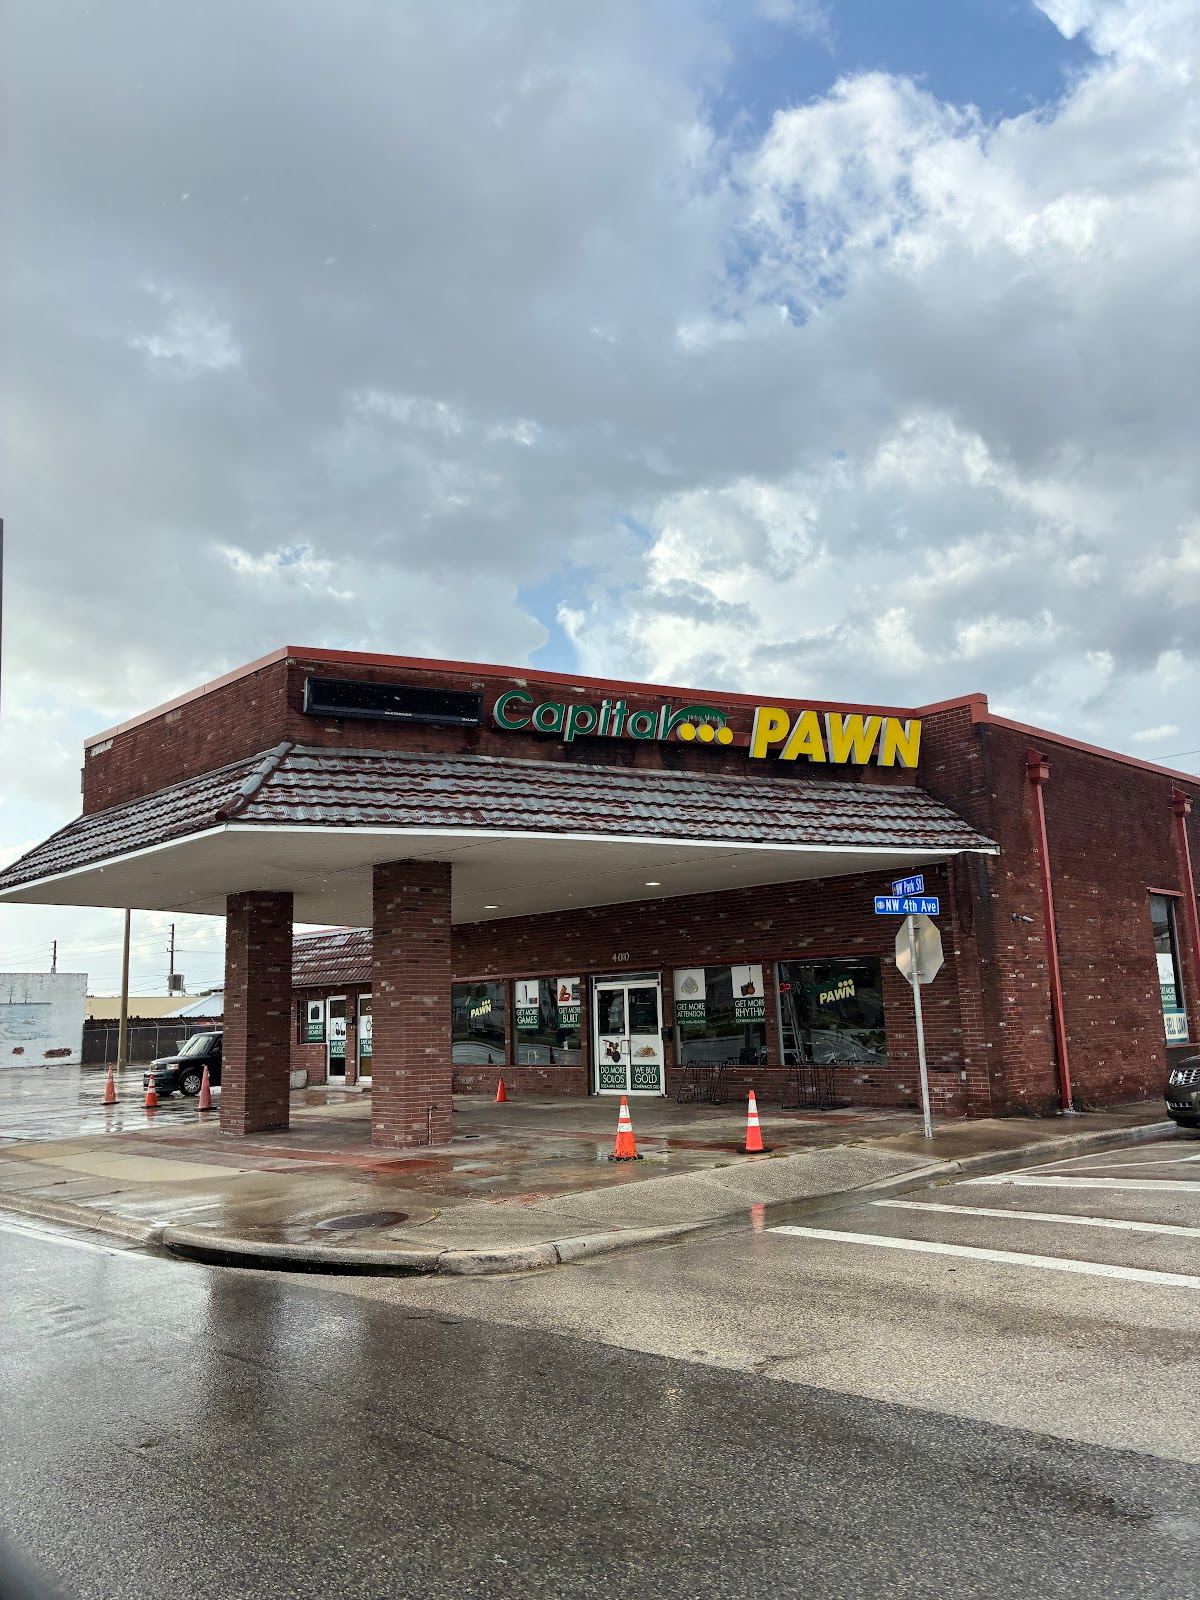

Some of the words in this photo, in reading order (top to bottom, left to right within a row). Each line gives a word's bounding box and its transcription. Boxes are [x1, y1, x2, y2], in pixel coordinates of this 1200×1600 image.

[493, 690, 686, 742] Capital
[749, 706, 922, 768] PAWN
[903, 880, 915, 893] Park
[915, 878, 922, 891] St
[885, 899, 899, 911] NW
[903, 899, 918, 912] 4th
[921, 900, 936, 912] Ave
[611, 951, 630, 962] 400
[820, 985, 855, 1004] PAWN
[676, 1003, 687, 1011] GET
[688, 1002, 706, 1010] MORE
[734, 1000, 746, 1008] GET
[747, 998, 766, 1007] MORE
[470, 1003, 493, 1019] PAWN
[676, 1010, 706, 1018] ATTENTION
[517, 1016, 538, 1024] GAMES
[563, 1014, 578, 1023] BUILT
[603, 1075, 624, 1083] SOLOS
[635, 1074, 657, 1083] GOLD
